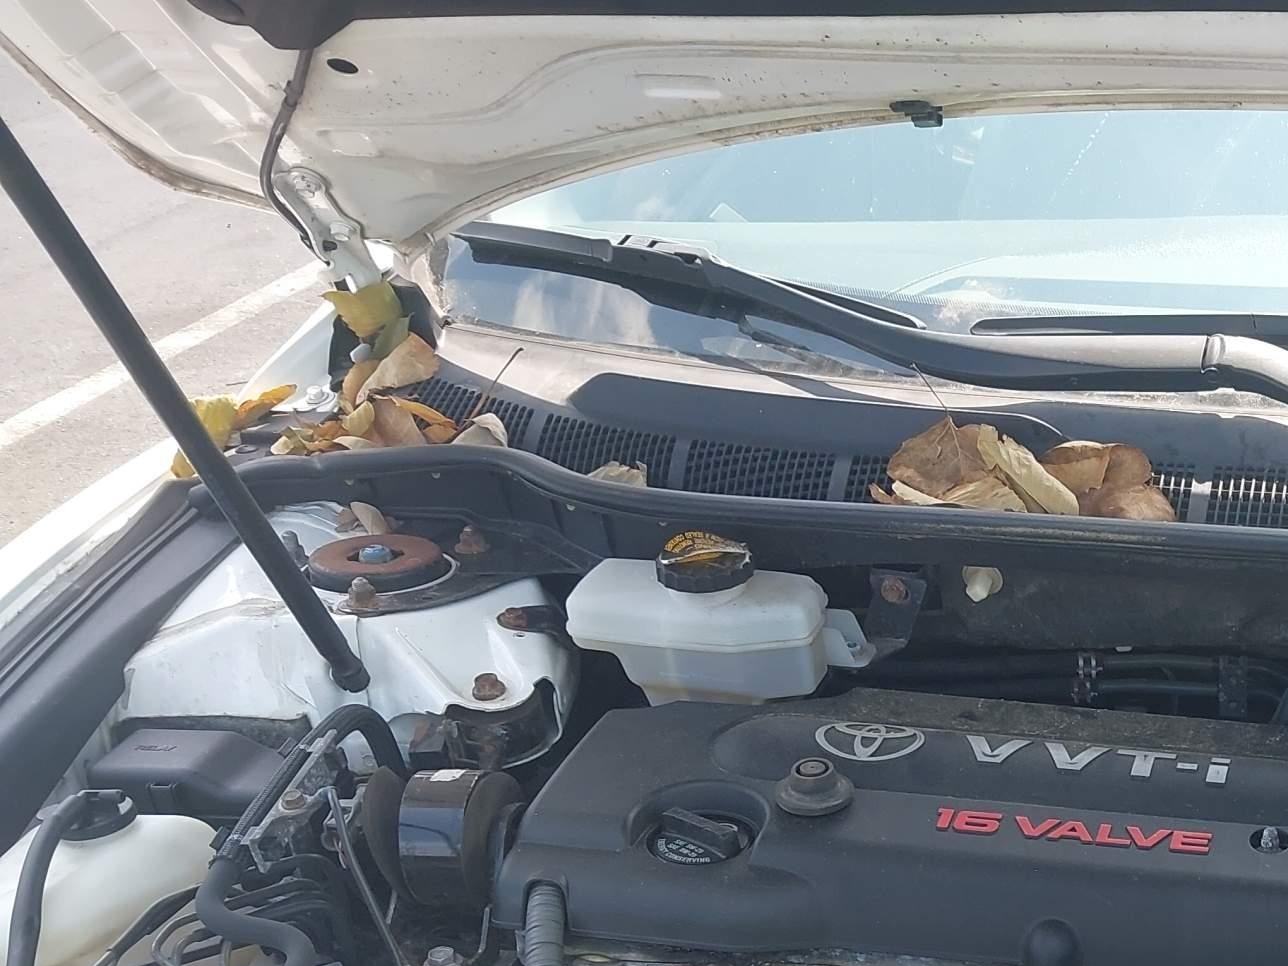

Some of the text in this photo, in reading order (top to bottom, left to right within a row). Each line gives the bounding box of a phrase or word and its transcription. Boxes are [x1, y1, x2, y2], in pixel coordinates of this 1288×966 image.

[966, 735, 1232, 784] VVT-i
[936, 807, 1213, 854] 16 VALVE
